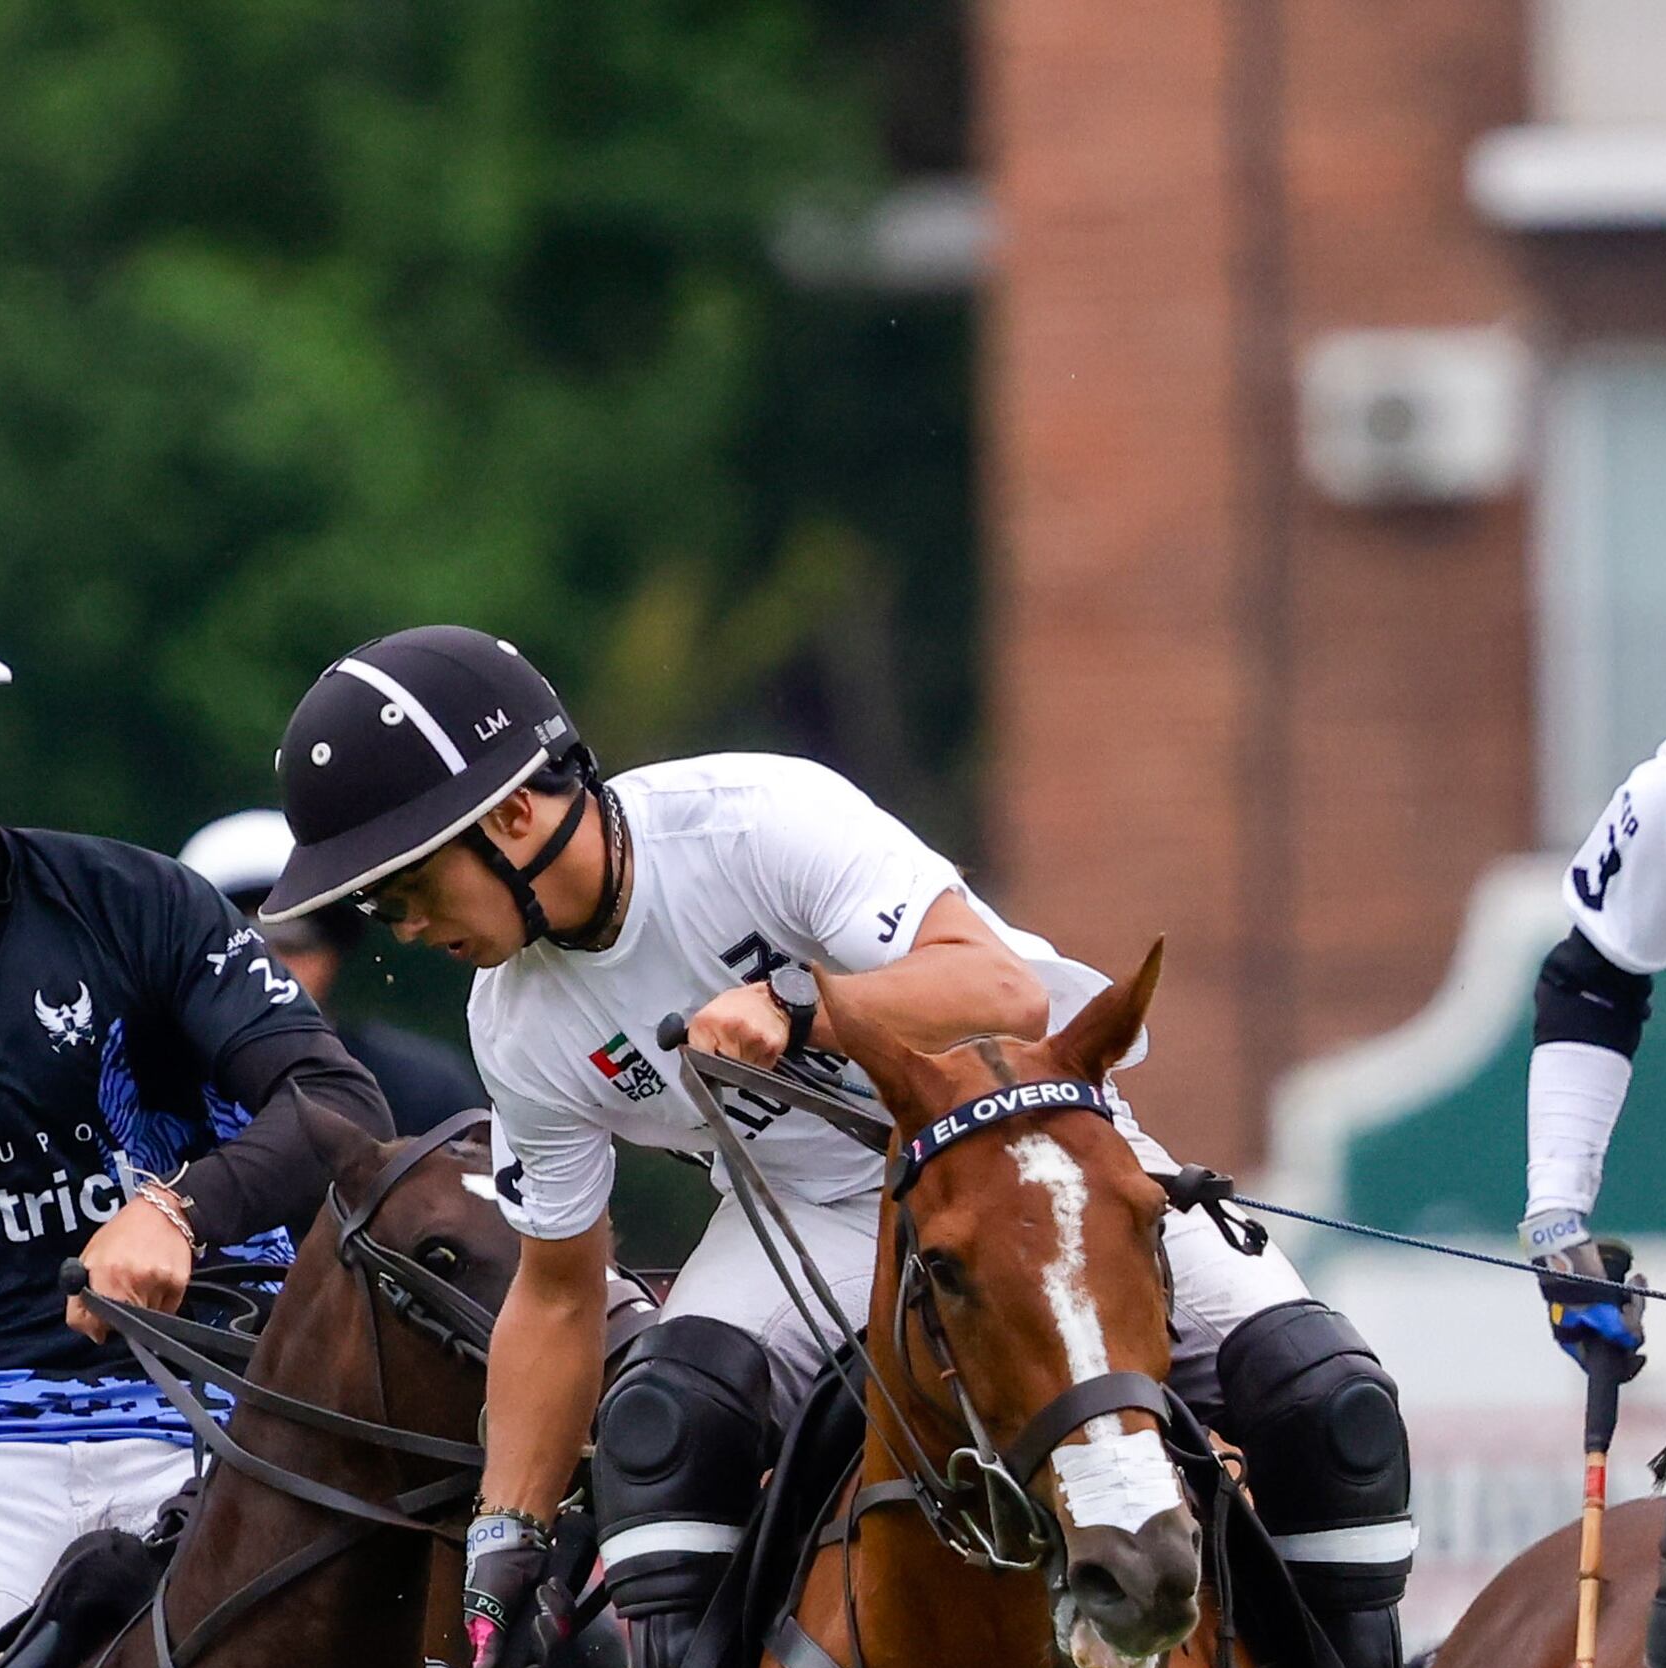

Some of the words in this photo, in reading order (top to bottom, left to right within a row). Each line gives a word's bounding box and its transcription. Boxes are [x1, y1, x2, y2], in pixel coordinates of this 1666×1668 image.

[474, 708, 512, 741] LM
[247, 957, 299, 1005] 3
[933, 1115, 969, 1145] EL
[972, 1083, 1081, 1121] OVERO
